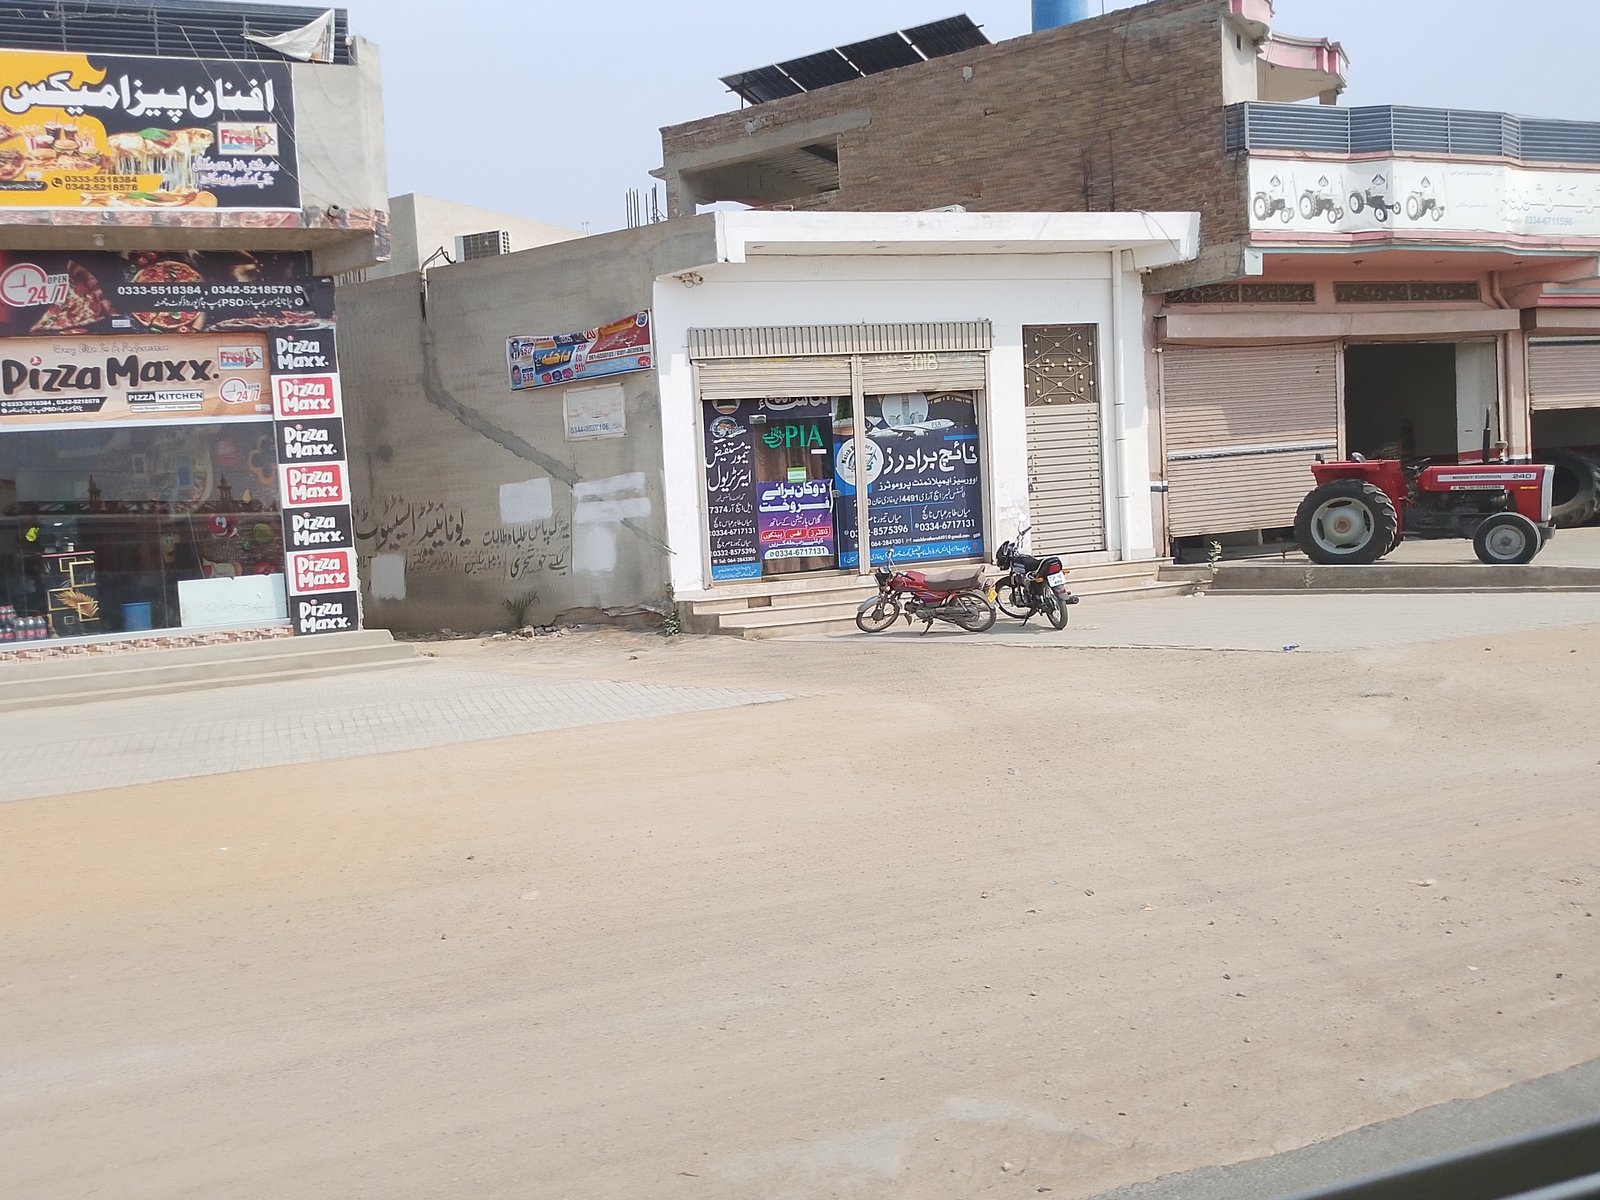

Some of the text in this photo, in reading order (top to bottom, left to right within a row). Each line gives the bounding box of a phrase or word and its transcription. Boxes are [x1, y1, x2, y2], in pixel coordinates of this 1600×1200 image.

[2, 71, 274, 123] افنان پیزا میکس
[65, 175, 138, 183] 0333-5518384
[47, 275, 67, 284] OPEN
[28, 284, 67, 303] 24/7
[118, 286, 201, 295] 0333-5518384
[211, 286, 292, 294] 0342-5218578
[222, 298, 244, 307] PSO
[276, 336, 320, 354] Pizza
[278, 354, 329, 370] Maxx.
[903, 353, 939, 371] 3018
[2, 356, 101, 395] Pizza
[128, 392, 203, 401] PIZZA KITCHEN
[236, 389, 260, 402] 24/7
[281, 380, 325, 397] Pizza
[283, 397, 331, 413] Maxx
[284, 424, 328, 443] Pizza
[785, 425, 824, 448] PIA
[286, 442, 337, 458] Maxx.
[883, 447, 938, 475] برادرز
[289, 468, 333, 486] Pizza
[291, 485, 338, 500] Maxx
[795, 481, 827, 498] دوکان
[759, 497, 830, 513] فروخت
[902, 495, 919, 503] 4491
[709, 506, 728, 514] 7374
[292, 512, 335, 531] Pizza
[920, 519, 975, 531] 0334-6717131
[294, 530, 344, 546] Maxx.
[711, 527, 756, 537] 0334-6717131
[713, 548, 757, 557] 0332-8575396
[774, 548, 826, 557] 0334-6717131
[297, 555, 340, 573] Pizza
[298, 572, 346, 588] Maxx
[299, 599, 342, 618] Pizza
[300, 617, 351, 633] Maxx.
